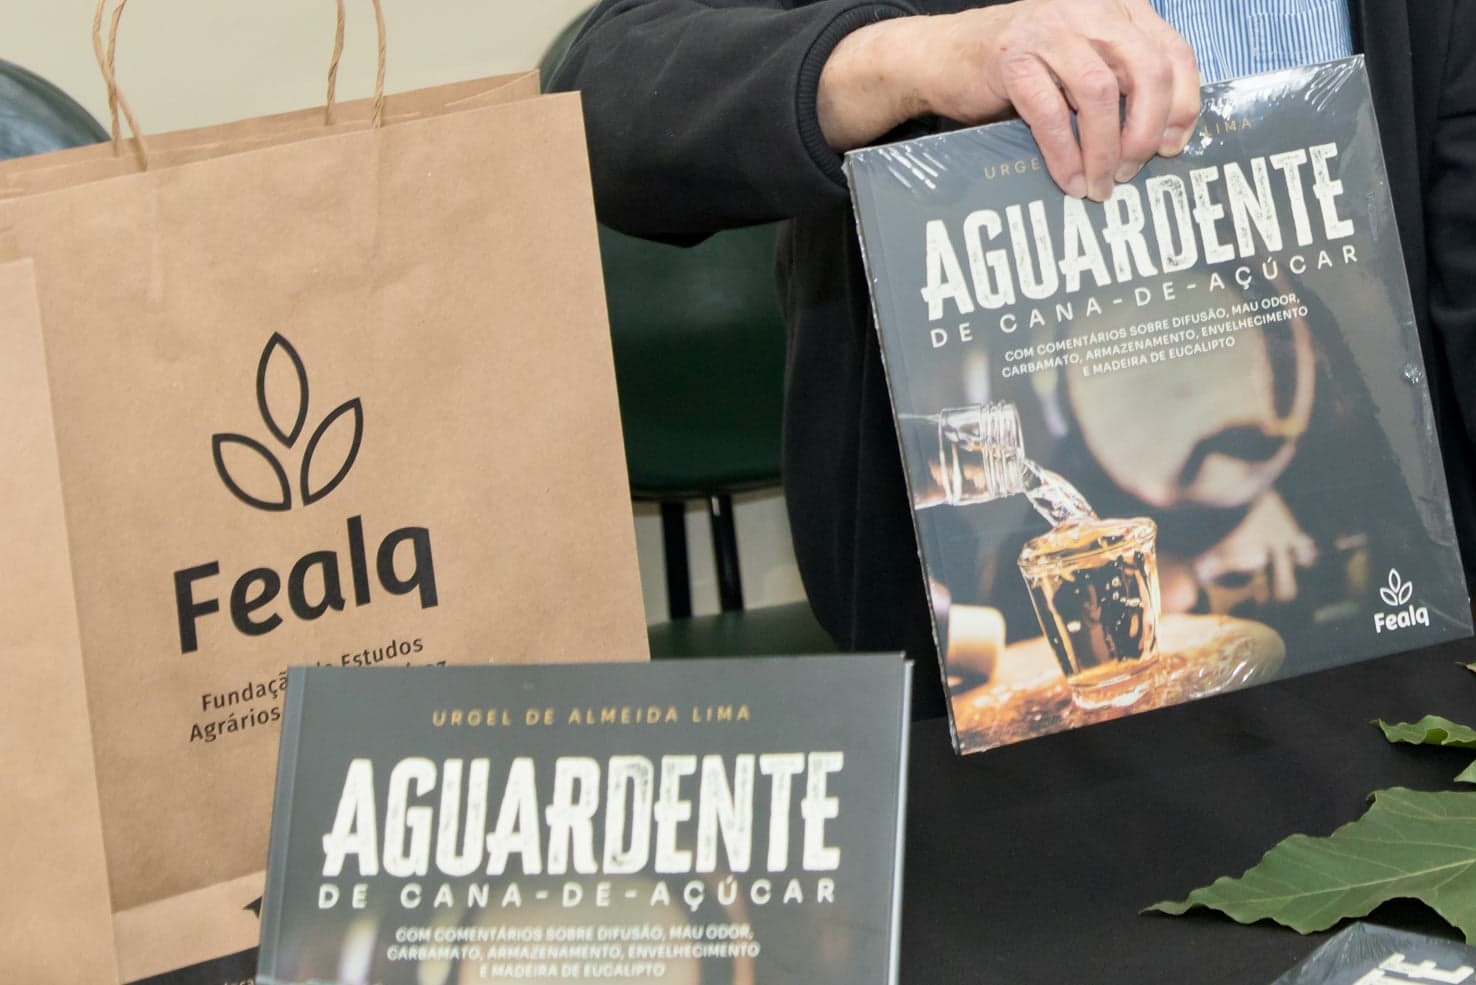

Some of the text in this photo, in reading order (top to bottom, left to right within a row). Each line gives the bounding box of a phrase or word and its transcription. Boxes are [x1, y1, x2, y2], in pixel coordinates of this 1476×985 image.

[983, 158, 1041, 180] URGE
[921, 142, 1355, 321] AGUARDENTE
[930, 245, 1359, 349] DE CANA-DE-AÇÚCAR
[1001, 305, 1309, 378] CARBAMATO, ARMAZENAMENTO, ENVELHECIMENTO
[1004, 293, 1301, 362] COM COMENTÁRIOS SOBRE DIFUSÃO, MAU ODOR,
[1092, 354, 1149, 374] MADEIRA
[1150, 349, 1167, 363] DE
[1168, 336, 1236, 359] EUCALIPTO
[173, 514, 439, 655] Fealq
[1374, 604, 1430, 634] Fealq
[201, 637, 424, 713] Fundaçã Estudos
[190, 704, 281, 743] Agrários
[432, 704, 751, 727] URGEL DE ALMEIDA LIMA
[322, 750, 845, 877] AGUARDENTE
[318, 877, 836, 914] DE CANA-DE-AÇÚCAR
[386, 941, 761, 962] CARBAMATO, ARMAZENAMENTO, ENVELHECIMENTO
[395, 922, 754, 943] COM COMENTÁRIOS SOBRE DIFUSÃO, MAU ODOR,
[491, 964, 557, 979] MADEIRA
[561, 963, 579, 978] DE
[582, 961, 667, 978] EUCALIPTO
